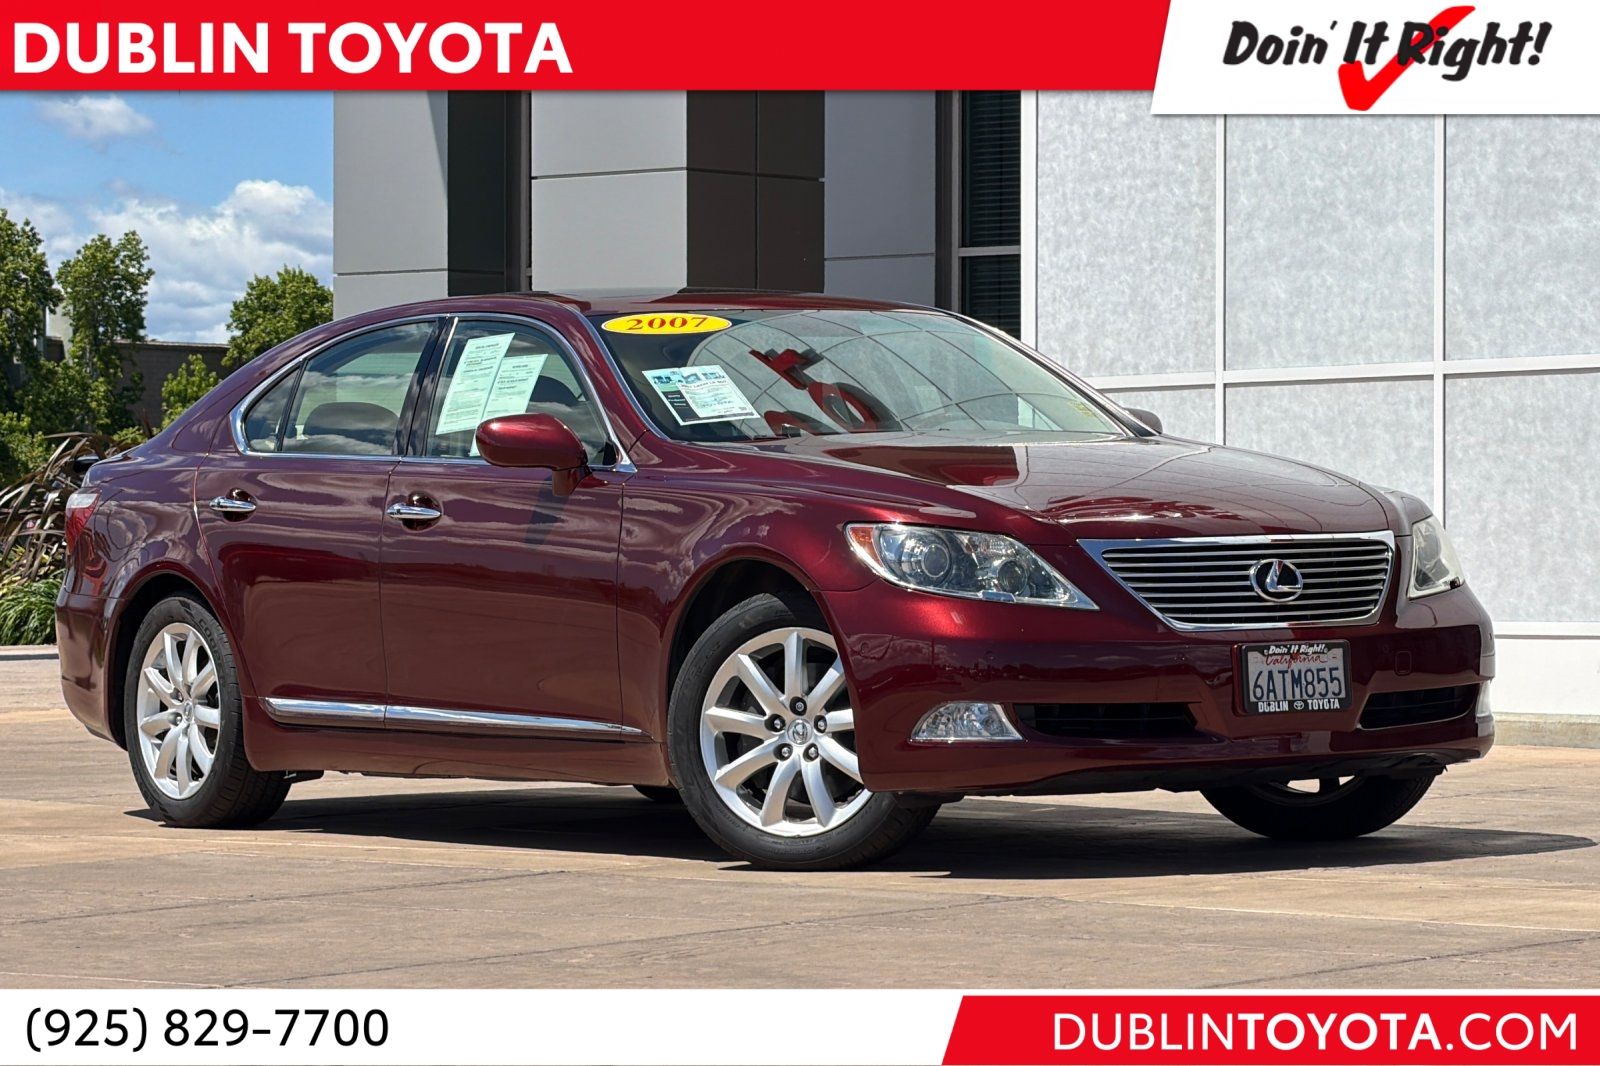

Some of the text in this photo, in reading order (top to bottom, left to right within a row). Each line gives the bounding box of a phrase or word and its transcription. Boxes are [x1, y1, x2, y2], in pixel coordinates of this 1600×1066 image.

[626, 316, 708, 330] 2007
[1253, 667, 1342, 701] 6ATM855
[1258, 699, 1341, 713] DUBLIN TOYOTA
